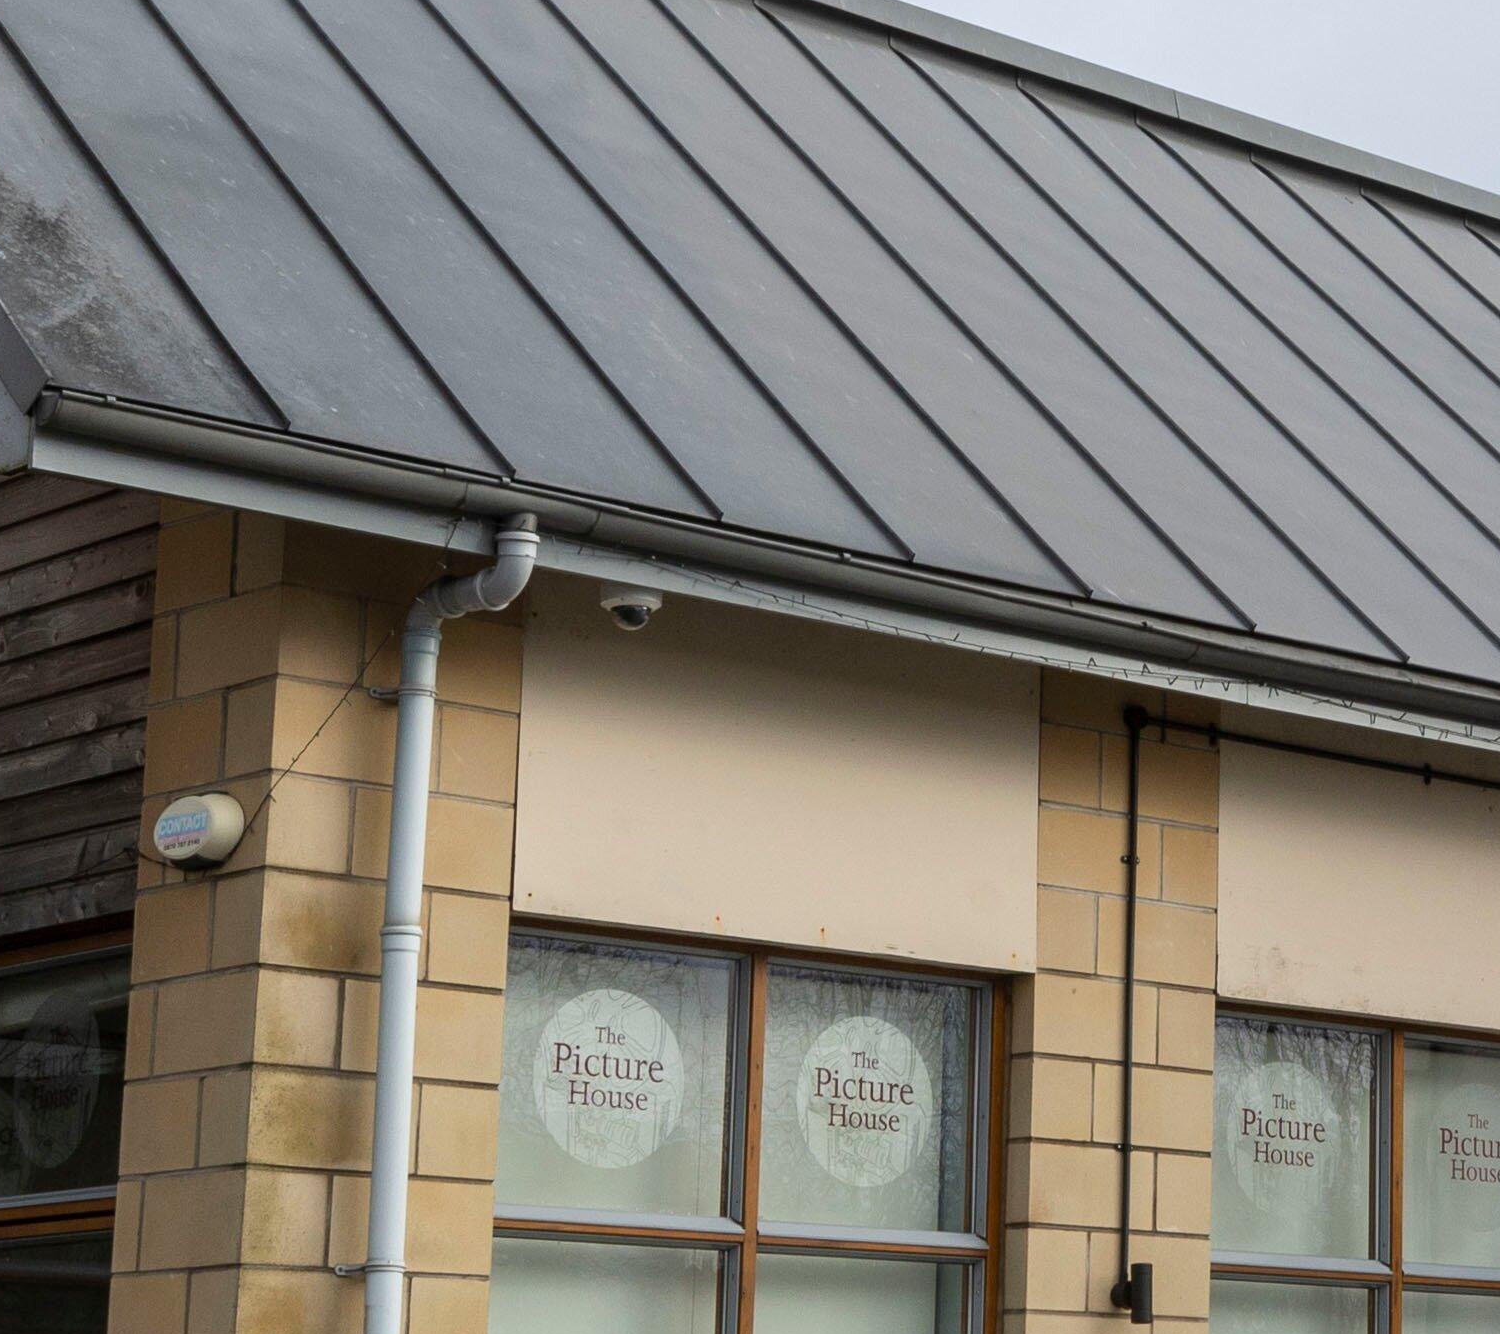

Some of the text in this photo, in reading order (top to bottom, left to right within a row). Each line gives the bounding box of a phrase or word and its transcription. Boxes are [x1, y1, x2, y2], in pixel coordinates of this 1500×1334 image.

[159, 811, 207, 836] CONTACT
[595, 1026, 626, 1047] The
[552, 1041, 664, 1084] Picture
[851, 1051, 880, 1071] The
[567, 1079, 649, 1111] House
[813, 1067, 915, 1106] Picture
[1272, 1093, 1297, 1112] The
[827, 1102, 901, 1133] House
[1240, 1108, 1326, 1143] Picture
[1467, 1113, 1489, 1131] The
[1253, 1140, 1315, 1168] House
